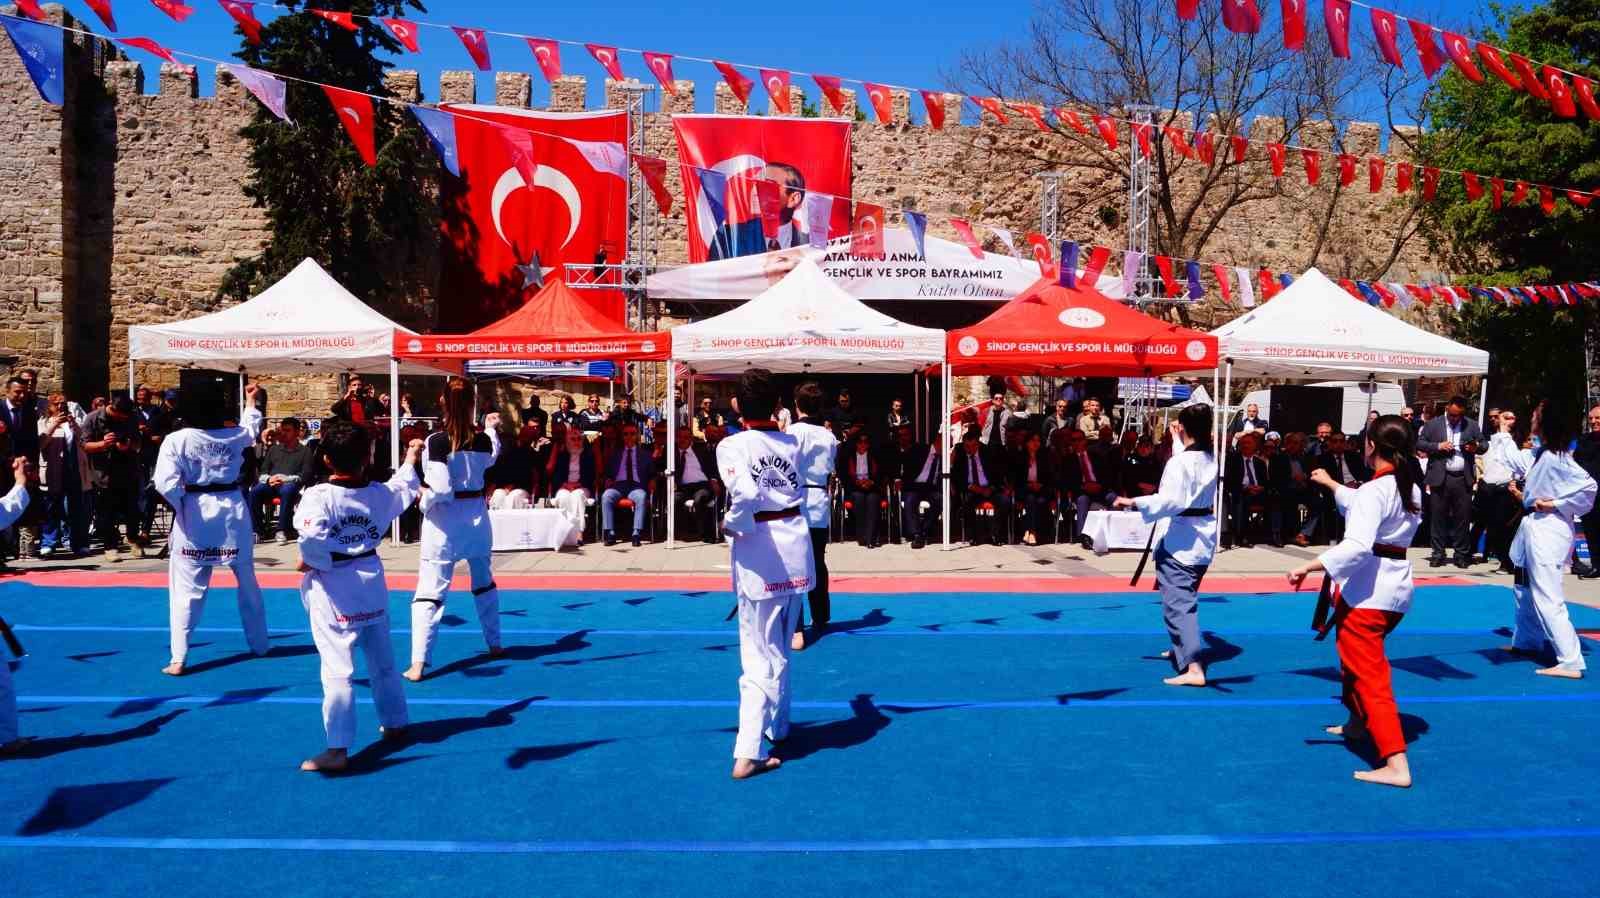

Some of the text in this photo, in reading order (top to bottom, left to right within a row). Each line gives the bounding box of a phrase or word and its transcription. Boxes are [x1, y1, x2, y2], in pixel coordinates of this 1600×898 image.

[890, 252, 926, 262] ANMA
[823, 266, 1003, 280] GENÇLİK VE SPOR BAYRAMIMIZ
[918, 282, 1006, 297] Kutlu Olsun
[168, 336, 197, 348] SİNOP
[198, 337, 239, 351] GENÇLİK
[240, 339, 253, 349] VE
[255, 339, 280, 349] SPOR
[467, 342, 509, 355] GENÇLİK
[511, 343, 524, 353] VE
[526, 343, 553, 353] SPOR
[555, 342, 565, 353] İL
[711, 336, 742, 348] SİNOP
[744, 337, 785, 349] GENÇLİK
[801, 337, 828, 347] SPOR
[986, 341, 1178, 354] SİNOP GENÇLİK VE SPOR İL MÜDÜRLÜĞÜ
[1264, 345, 1294, 357] SİNOP
[1337, 351, 1349, 360] VE
[1350, 351, 1376, 362] SPOR
